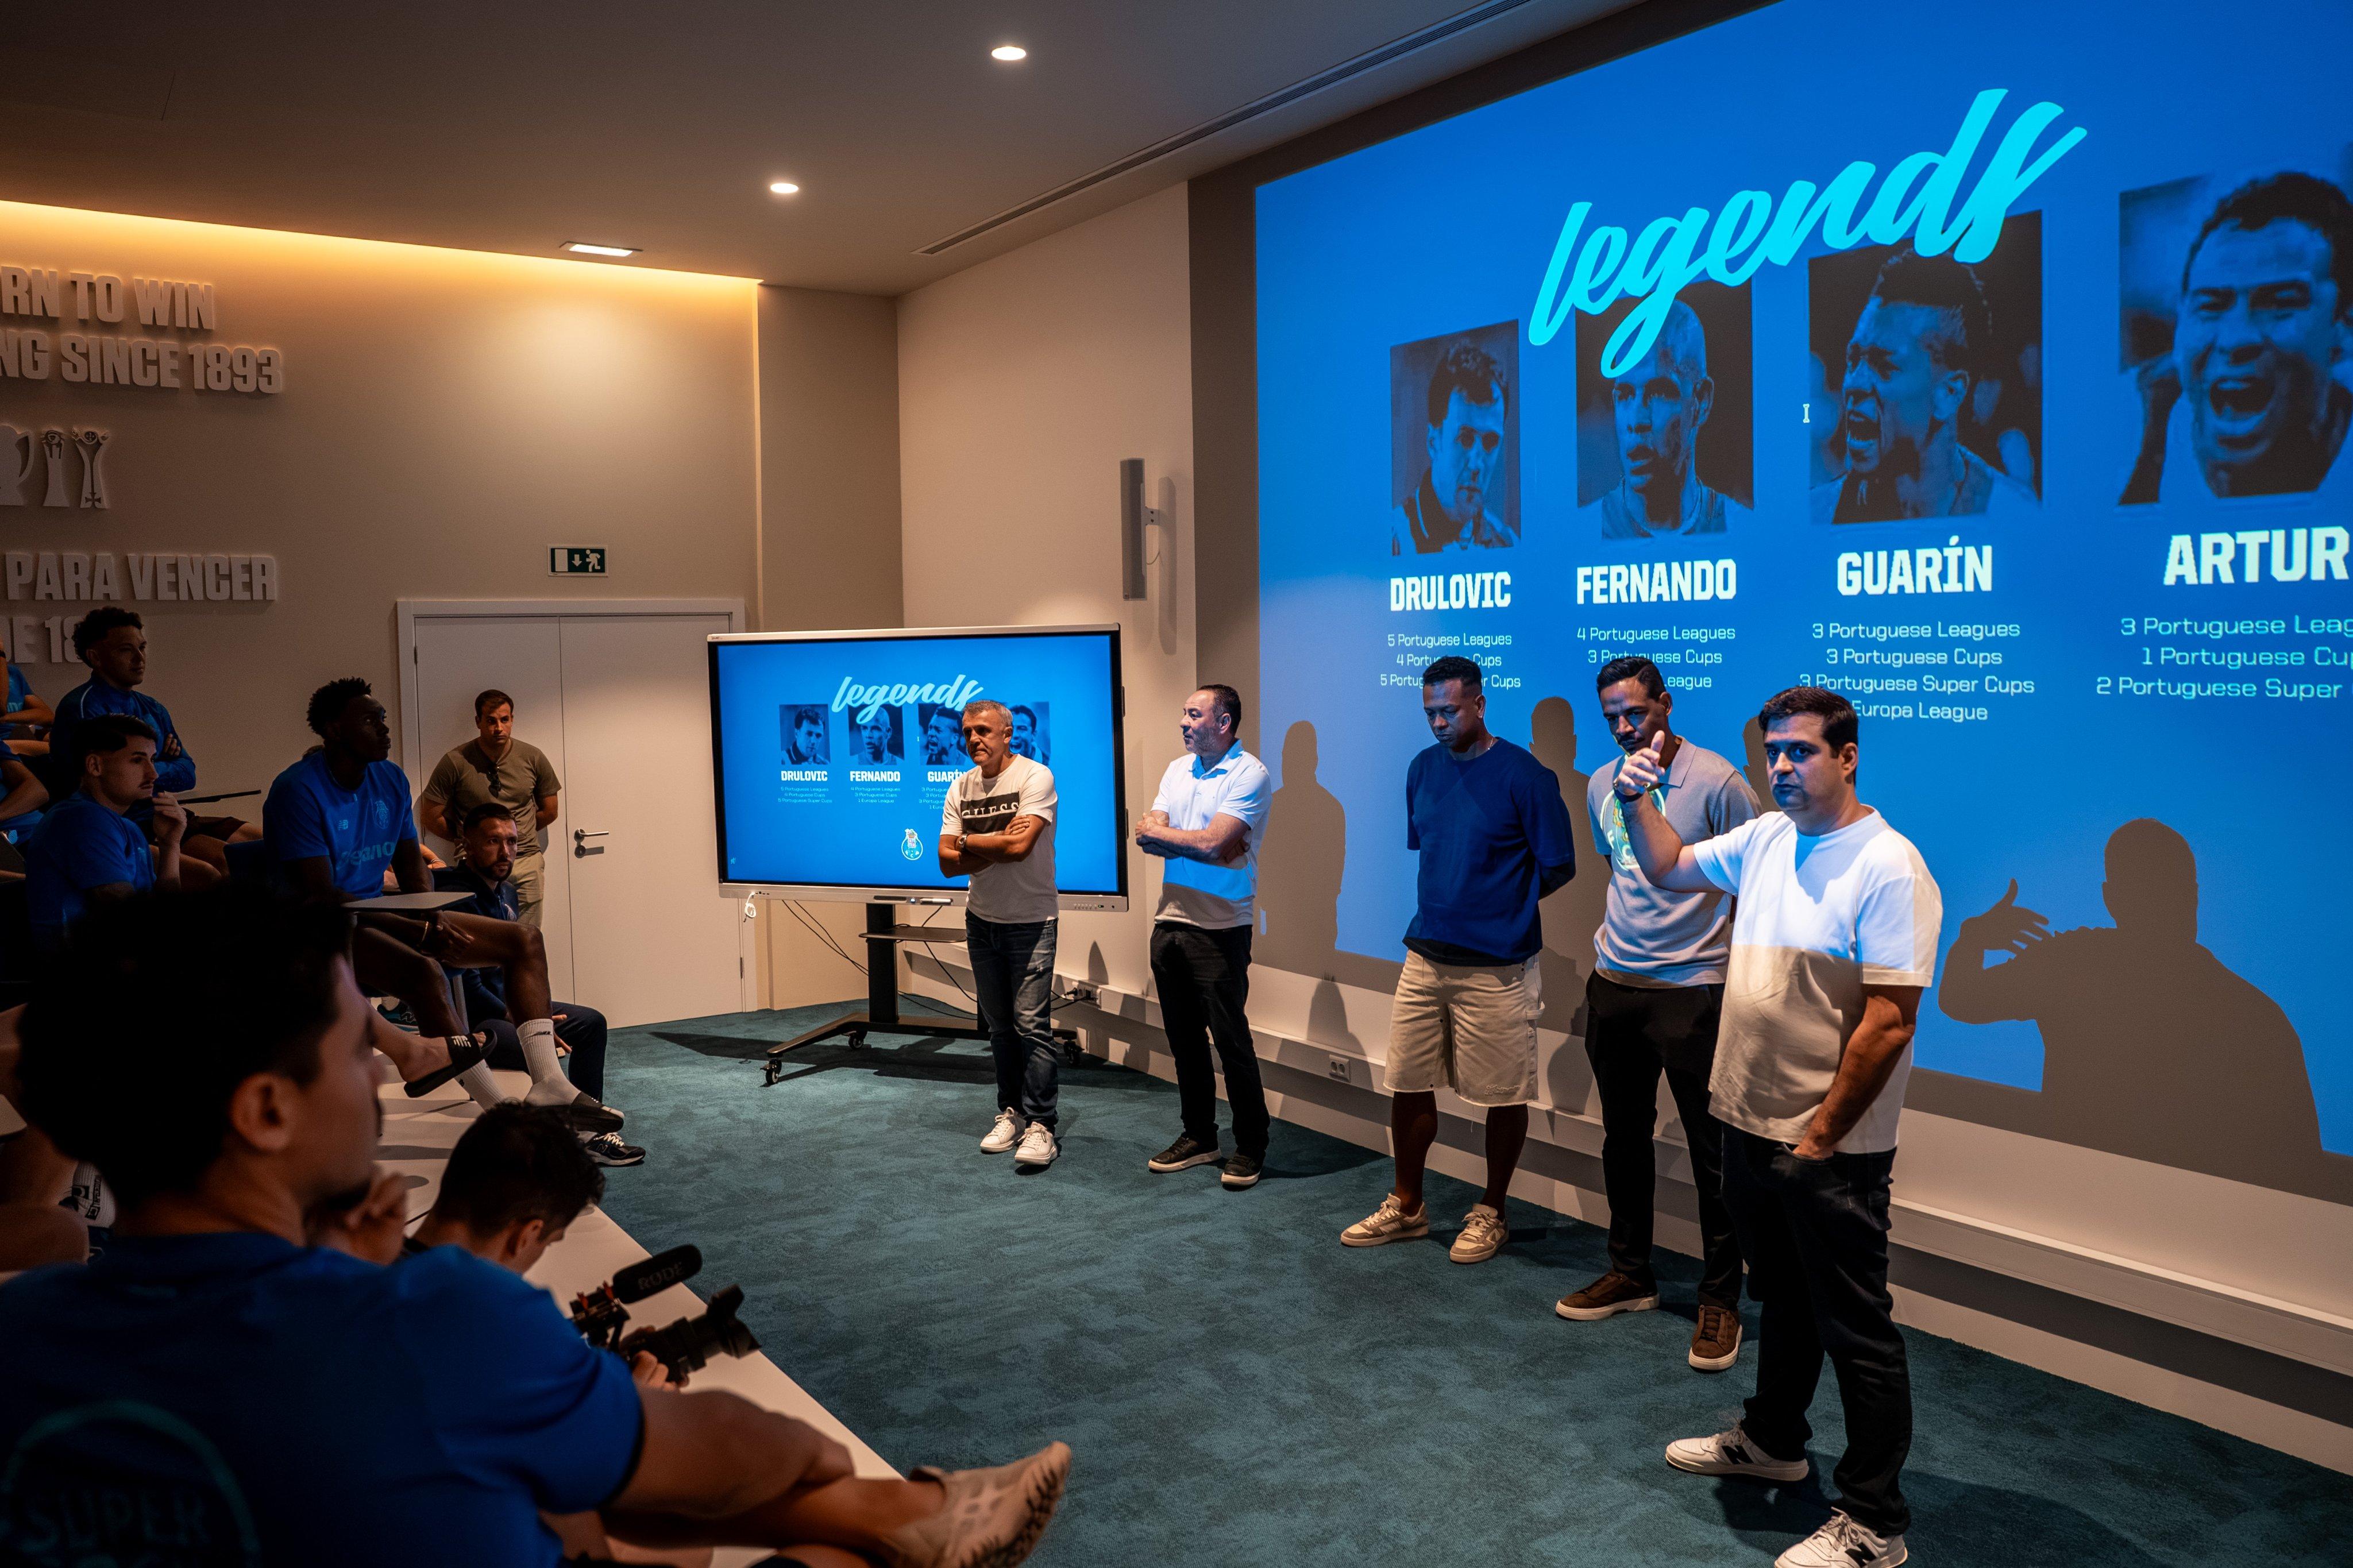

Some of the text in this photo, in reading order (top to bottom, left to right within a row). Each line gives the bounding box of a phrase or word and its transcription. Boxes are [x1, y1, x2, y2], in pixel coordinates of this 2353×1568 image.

[1529, 88, 2088, 378] legends
[70, 272, 124, 322] TO
[134, 278, 215, 330] WIN
[60, 334, 180, 388] SINCE
[188, 344, 282, 393] 1893
[1837, 535, 1993, 596] GUARÍN
[2163, 526, 2350, 585] ARTUR
[6, 552, 277, 601] PARA VENCER
[1577, 558, 1737, 605] FERNANDO
[1390, 571, 1511, 612] DRULOVIC
[1577, 625, 1735, 643] 4 Portuguese Leagues
[1812, 621, 2020, 642] 3 Portuguese Leagues
[2121, 617, 2136, 635] 3
[2144, 617, 2285, 639] Portuguese
[1388, 632, 1512, 648] 5 Portuguese Leagues
[1396, 654, 1403, 666] 4
[1473, 654, 1502, 668] Cups
[1588, 650, 1597, 663] 3
[1685, 648, 1722, 666] Cups
[1826, 648, 2003, 668] 3 Portuguese Cups
[2142, 646, 2353, 670] 1 Portuguese Cu
[1380, 674, 1387, 686] 5
[1491, 674, 1521, 690] Cups
[1664, 675, 1712, 690] eague
[1816, 674, 1918, 694] Portuguese
[1922, 675, 1978, 695] Super
[1984, 675, 2035, 696] Cups
[2096, 677, 2343, 701] 2 Portuguese Super
[831, 674, 984, 724] legends
[1851, 700, 1988, 723] Europa League
[781, 770, 828, 781] DRULOVIC
[850, 771, 901, 782] FERNANDO
